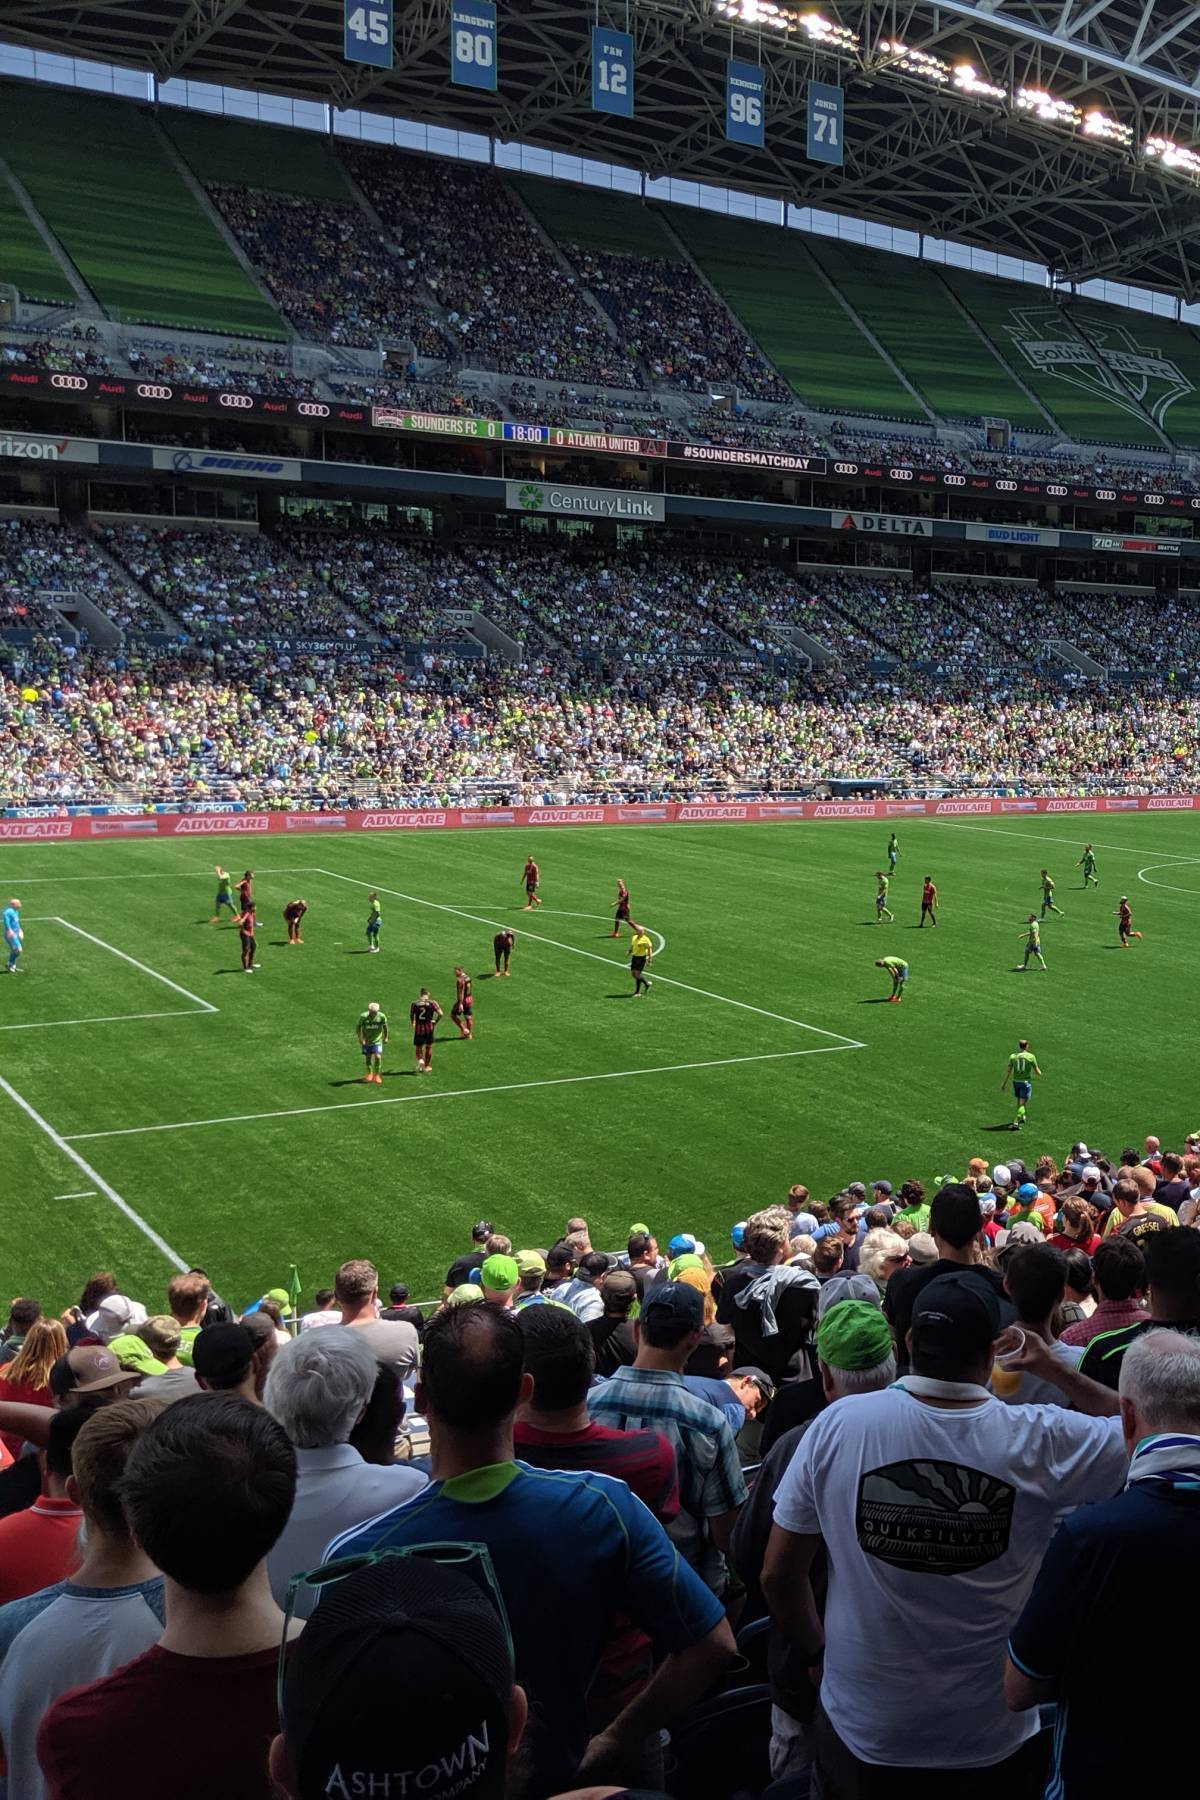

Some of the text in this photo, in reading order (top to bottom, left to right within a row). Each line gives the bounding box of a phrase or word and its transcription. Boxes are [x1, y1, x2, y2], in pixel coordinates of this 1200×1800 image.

[348, 7, 389, 46] 45
[453, 13, 495, 29] LARGENT
[456, 30, 493, 67] 80
[603, 45, 623, 58] FAN
[598, 60, 627, 95] 12
[730, 77, 763, 91] KENNEDY
[730, 93, 761, 127] 96
[814, 98, 838, 112] JONES
[813, 113, 838, 146] 71
[11, 374, 39, 384] Audi
[100, 383, 125, 393] Audi
[184, 393, 208, 403] Audi
[264, 402, 287, 411] Audi
[339, 410, 363, 420] Audi
[411, 414, 478, 435] SOUNDERS FC
[487, 423, 496, 437] 0
[511, 426, 542, 443] 18:00
[556, 431, 564, 445] 0
[567, 432, 640, 452] ATLANTA UNITED
[200, 455, 283, 473] BOEING
[683, 446, 810, 470] #SOUNDERSMATCHDAY
[864, 469, 882, 477] Audi
[919, 474, 936, 482] Audi
[972, 480, 988, 488] Audi
[550, 491, 653, 516] CenturyLink
[862, 516, 925, 535] DELTA
[988, 529, 1040, 543] BUD LIGHT
[1094, 538, 1112, 548] 710
[936, 802, 992, 815] ADVOCARE
[1046, 799, 1097, 811] ADVOCARE
[1147, 797, 1193, 808] ADVOCARE
[529, 809, 605, 824] ADVOCARE
[679, 806, 747, 820] ADVOCARE
[814, 804, 876, 817] ADVOCARE
[175, 816, 269, 832] ADVOCARE
[361, 813, 446, 828] ADVOCARE
[419, 1007, 426, 1020] 2
[863, 1519, 1000, 1543] QUIKSILVER
[324, 1719, 490, 1800] ASHTOWN
